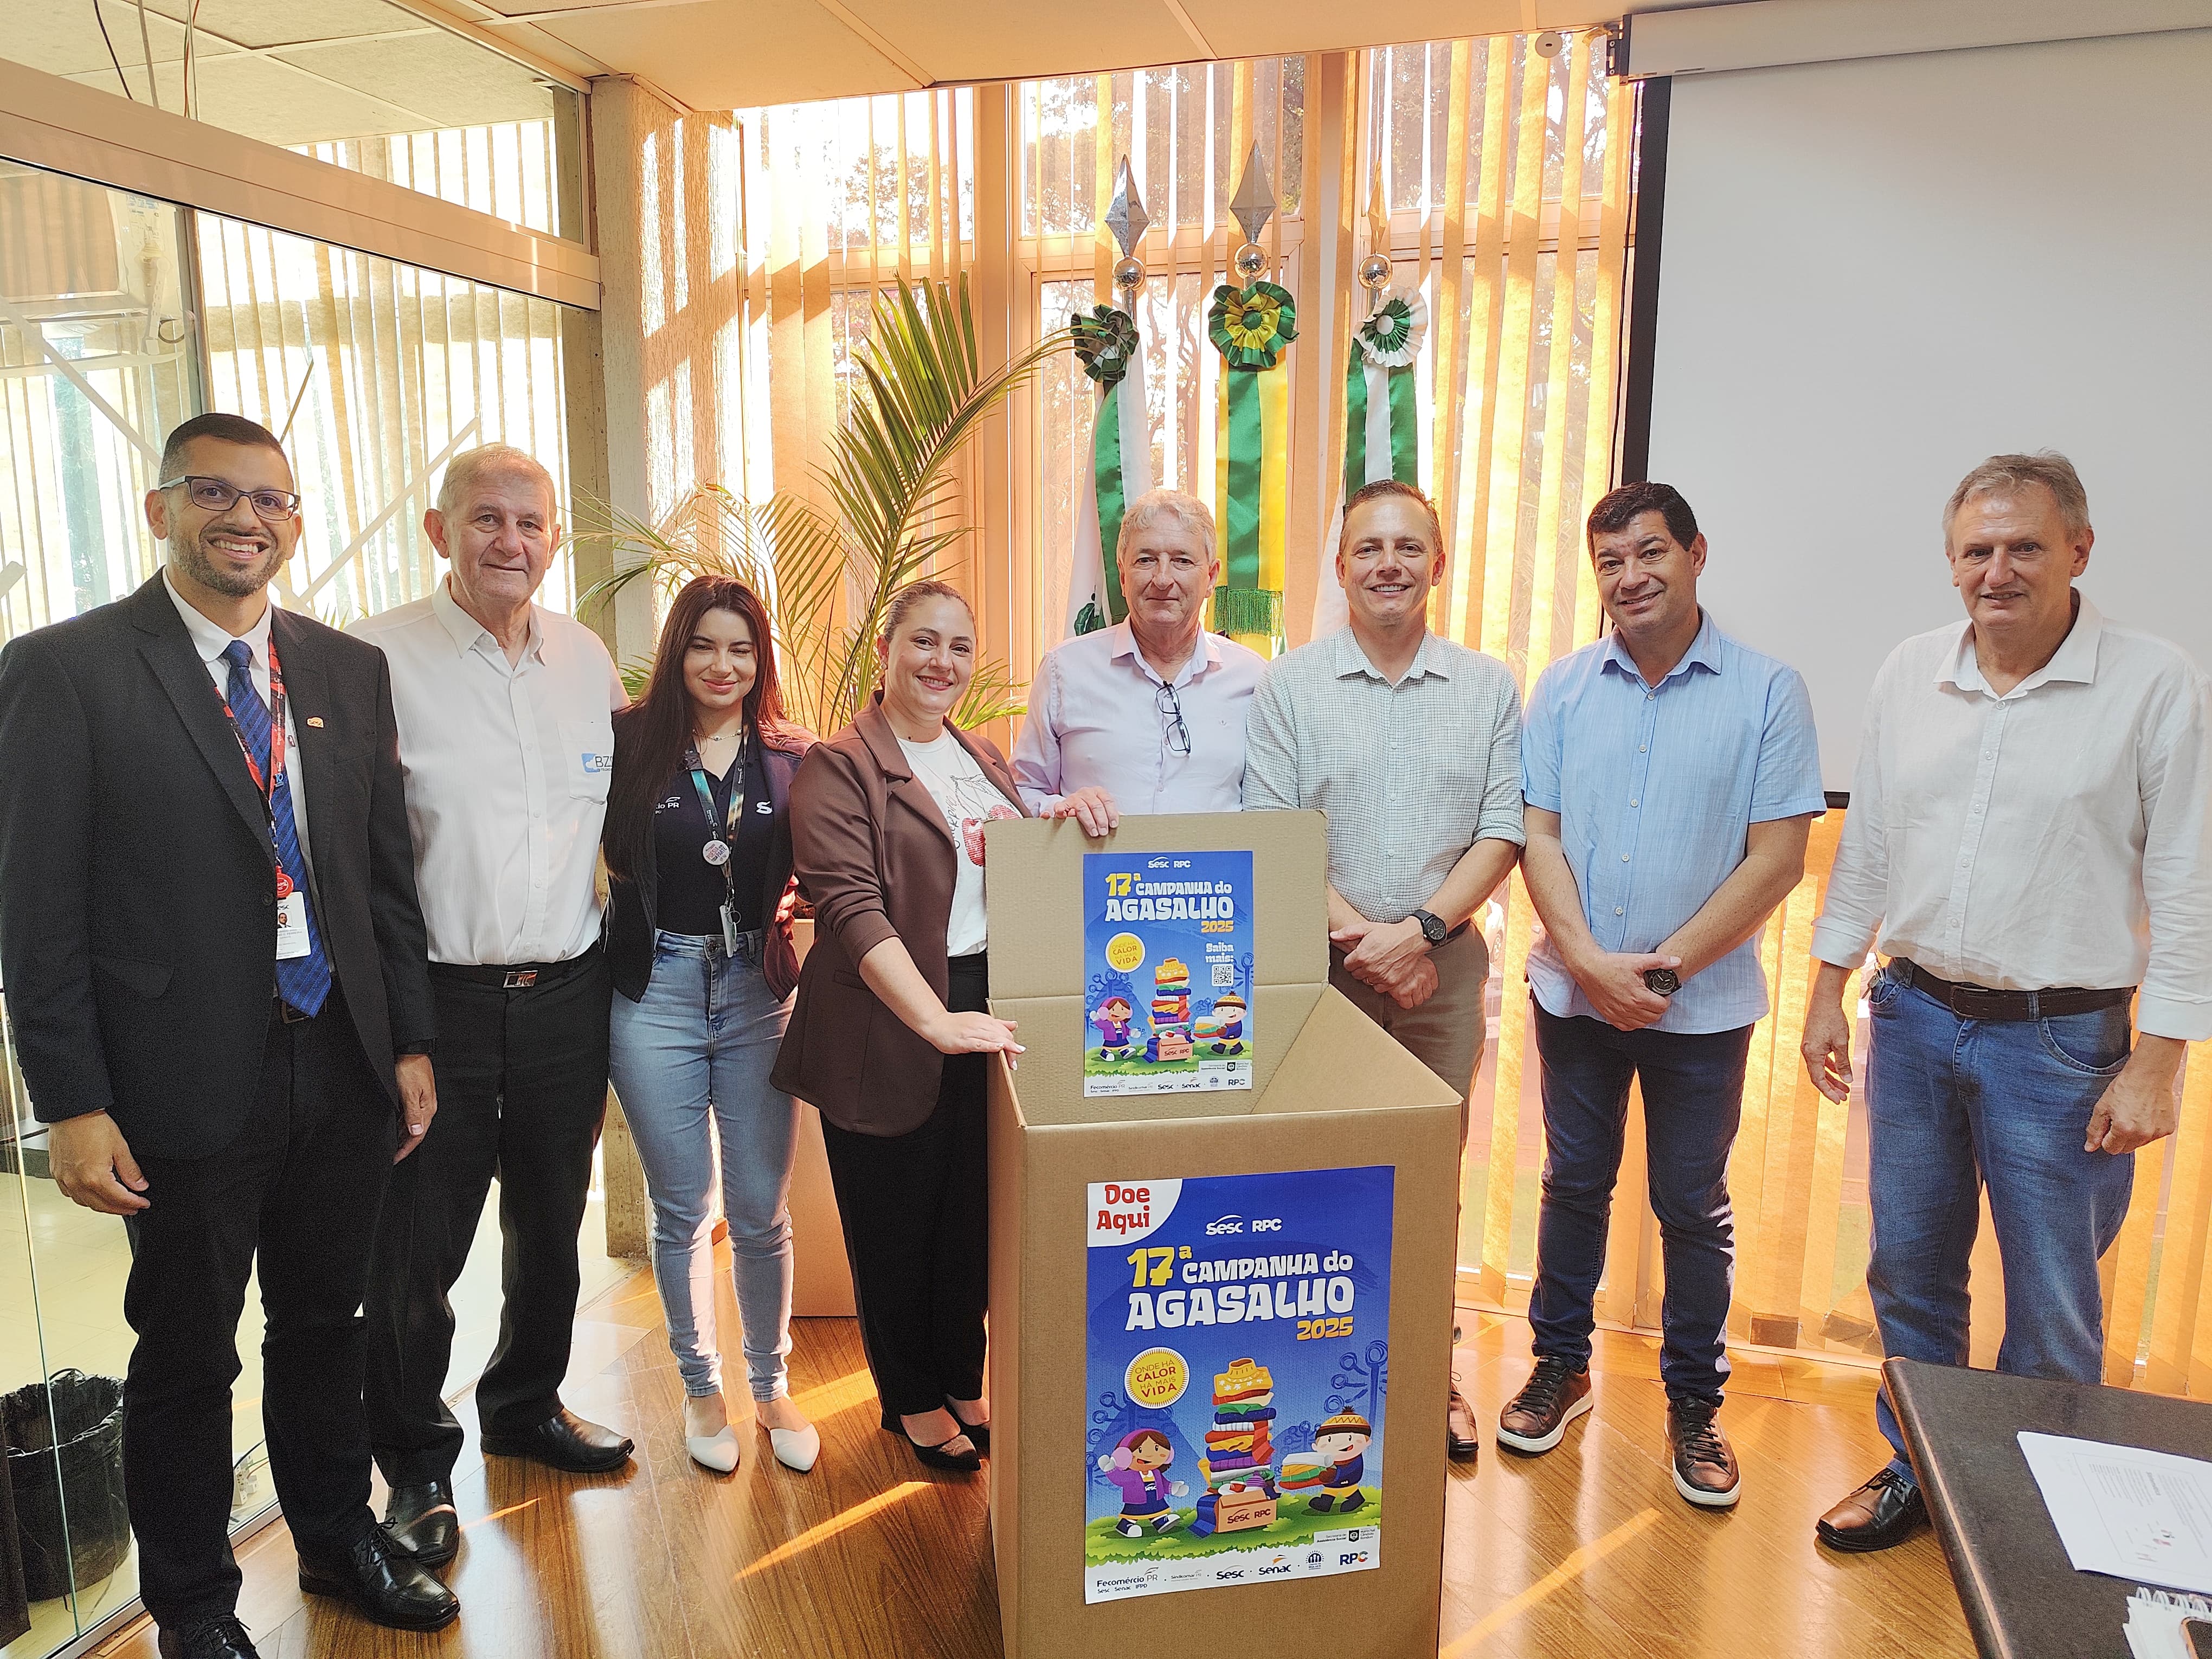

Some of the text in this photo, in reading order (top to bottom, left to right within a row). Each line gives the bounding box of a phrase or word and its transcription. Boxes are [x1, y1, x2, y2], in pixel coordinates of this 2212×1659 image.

[1136, 881, 1213, 896] CAMPANHA
[1215, 880, 1232, 894] do
[1105, 896, 1234, 922] AGASALHO
[1201, 921, 1233, 933] 2025
[1113, 946, 1137, 955] CALOR
[1206, 943, 1233, 953] Saiba
[1116, 956, 1137, 965] VIDA
[1205, 953, 1233, 963] mais:
[1105, 1185, 1150, 1205] Doe
[1096, 1205, 1150, 1235] Aqui
[1252, 1218, 1282, 1232] RPC
[1182, 1253, 1319, 1284] CAMPANHA
[1323, 1250, 1353, 1272] do
[1125, 1276, 1354, 1331] AGASALHO
[1296, 1316, 1353, 1341] 2025
[1135, 1358, 1175, 1374] ONDE HÁ
[1136, 1366, 1176, 1382] CALOR
[1156, 1376, 1176, 1386] MAIS
[1141, 1383, 1177, 1397] VIDA
[1254, 1509, 1271, 1518] RPC
[1258, 1562, 1291, 1576] Senac
[1340, 1551, 1368, 1566] RPC
[1097, 1574, 1158, 1587] Fecomércio PR
